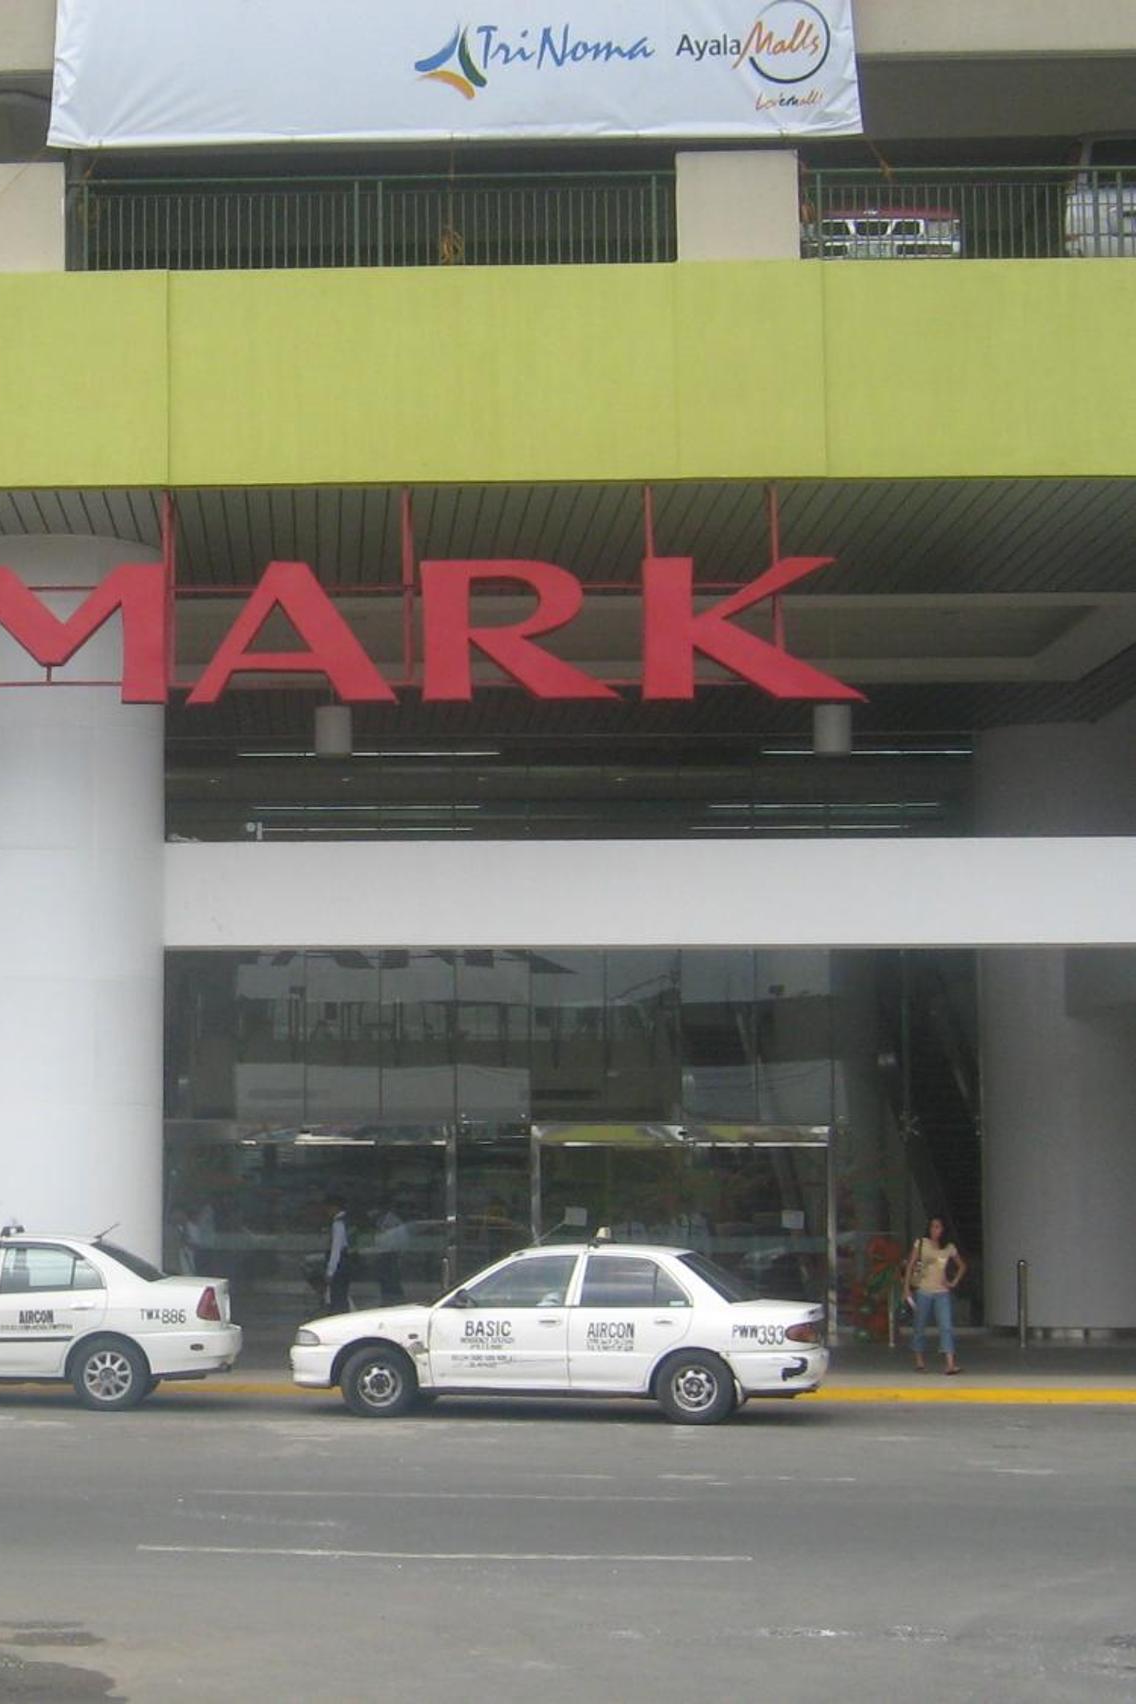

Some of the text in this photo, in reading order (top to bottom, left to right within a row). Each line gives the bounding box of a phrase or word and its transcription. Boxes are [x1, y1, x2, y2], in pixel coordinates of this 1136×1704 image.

[476, 23, 656, 70] TriNoma
[676, 19, 820, 70] Ayala Malls
[18, 1309, 54, 1325] AIRCON
[464, 1320, 512, 1337] BASIC
[586, 1322, 635, 1339] AIRCON
